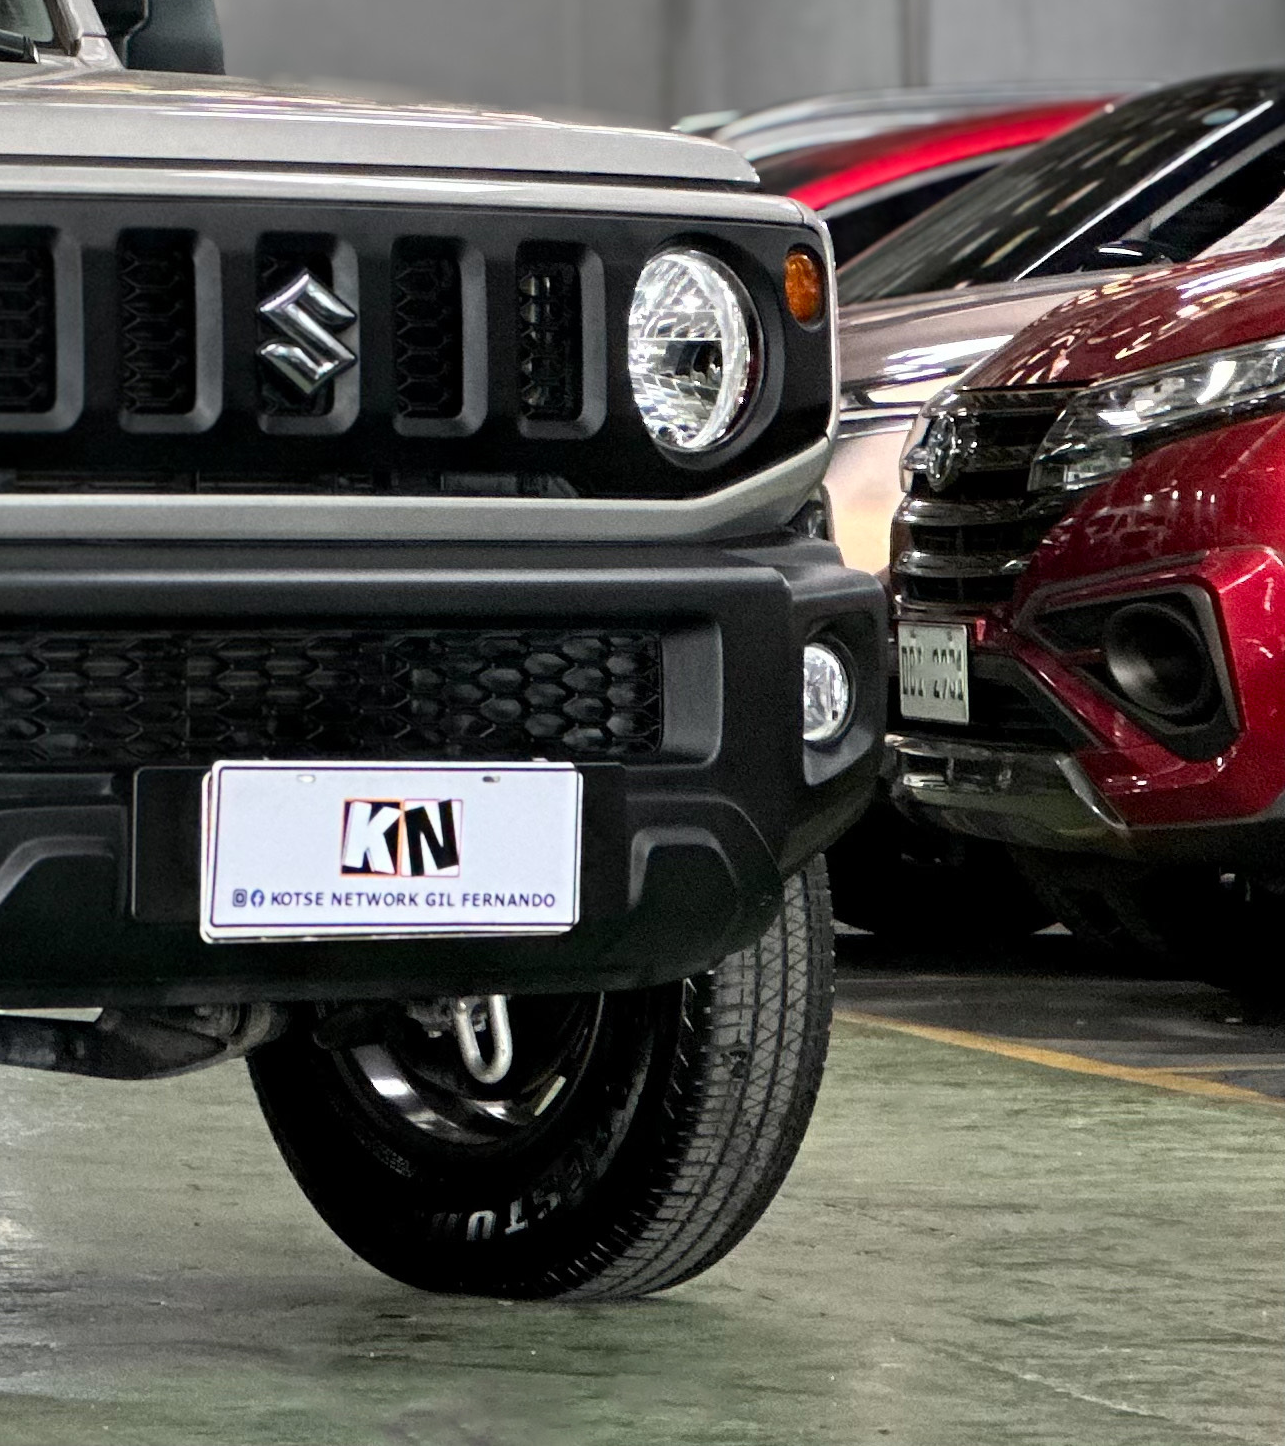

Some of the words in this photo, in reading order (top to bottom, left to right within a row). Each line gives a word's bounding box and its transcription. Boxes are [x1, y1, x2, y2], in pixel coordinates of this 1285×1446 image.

[341, 799, 462, 876] KN
[271, 893, 324, 906] KOTSE
[331, 893, 417, 907] NETWORK
[426, 893, 455, 907] GIL
[462, 893, 555, 908] FERNANDO
